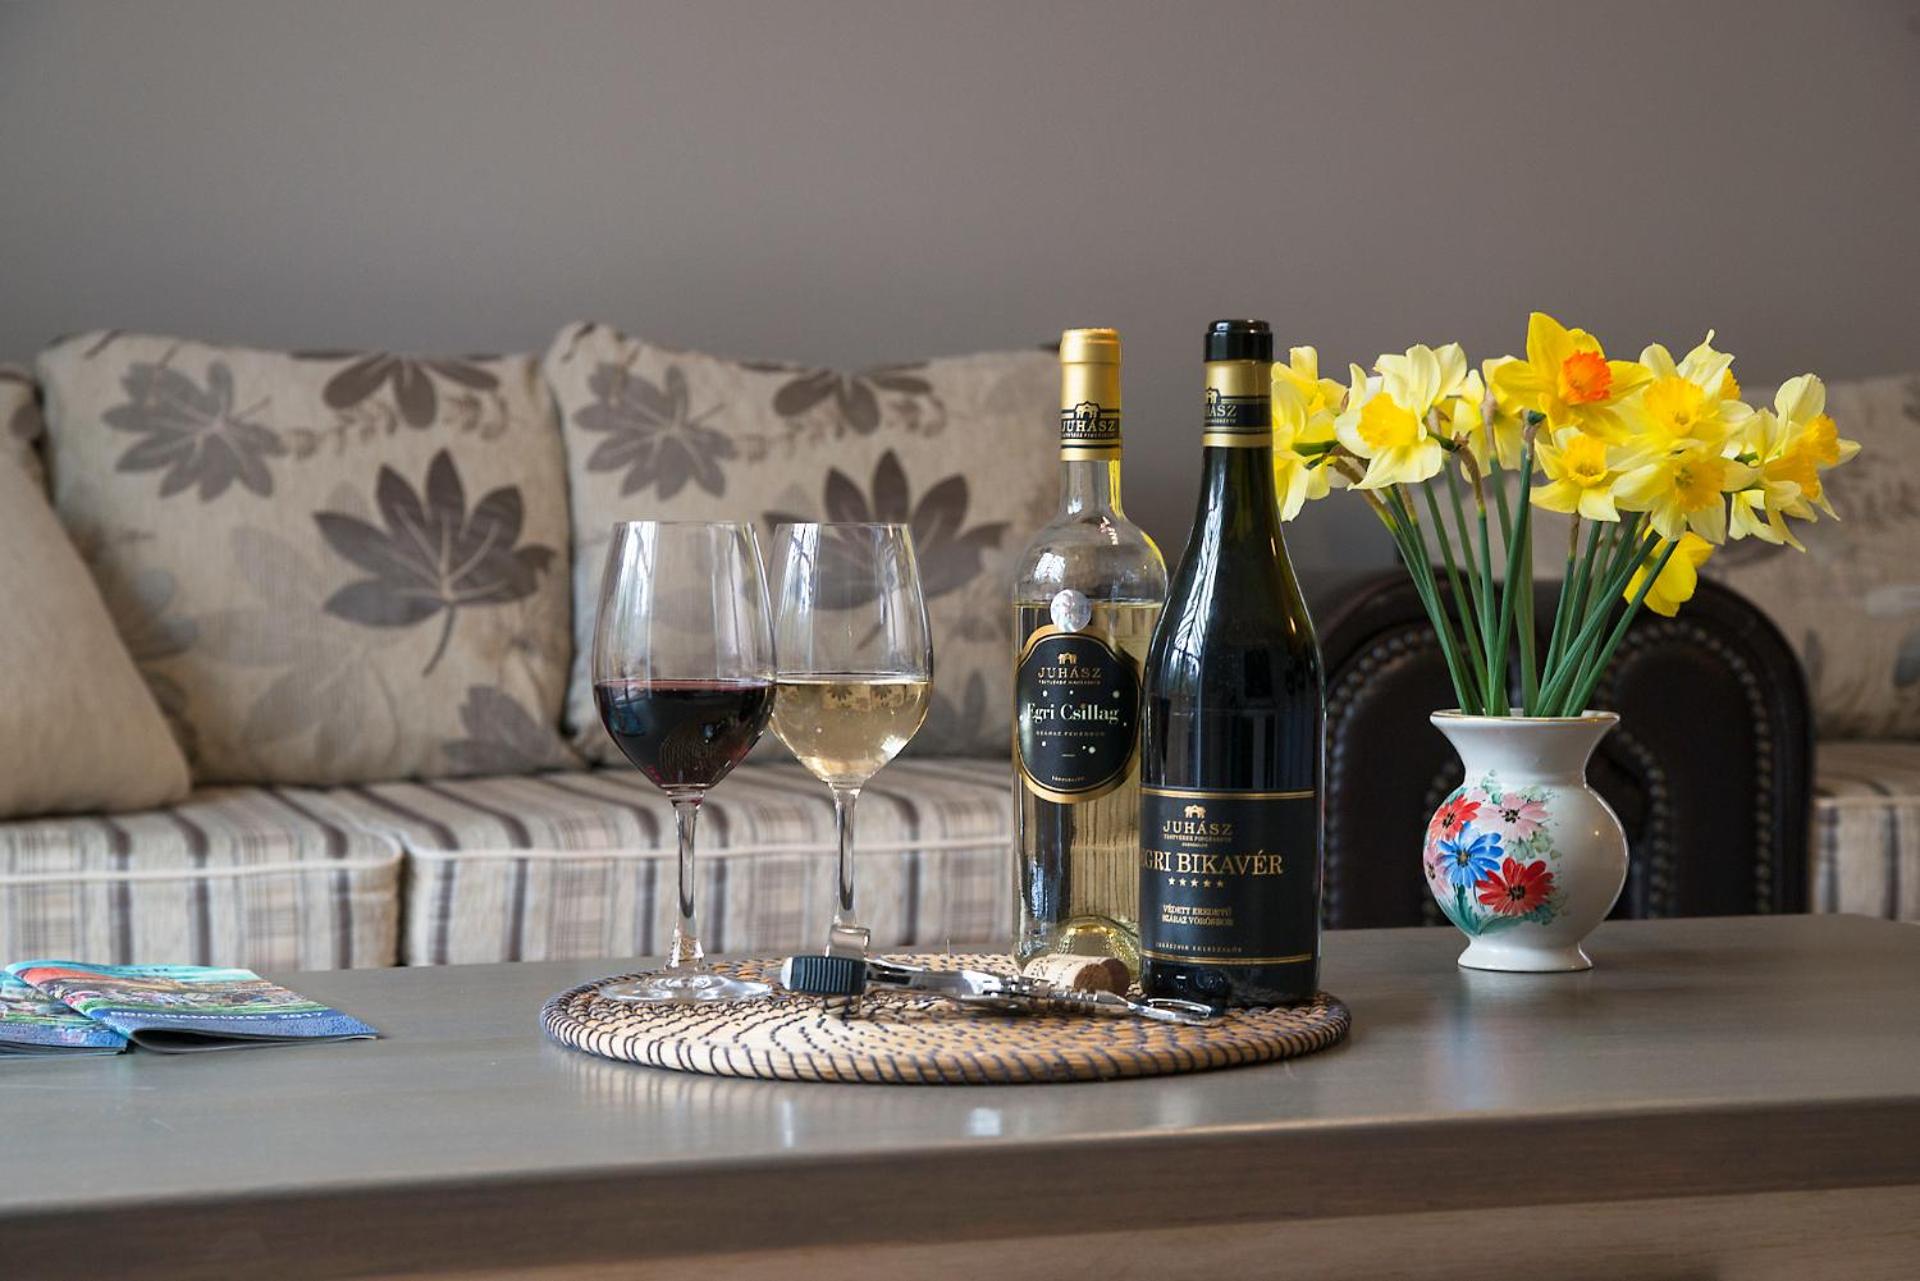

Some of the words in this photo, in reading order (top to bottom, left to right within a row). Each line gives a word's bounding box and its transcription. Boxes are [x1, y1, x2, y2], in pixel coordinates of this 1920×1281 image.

[1061, 418, 1116, 433] JUHÁSZ
[1037, 667, 1102, 679] JUHÁSZ
[1026, 702, 1055, 724] Egri
[1060, 702, 1120, 724] Csillag
[1162, 820, 1234, 836] JUHÁSZ
[1143, 849, 1172, 873] GRI
[1176, 848, 1284, 876] BIKAVÉR
